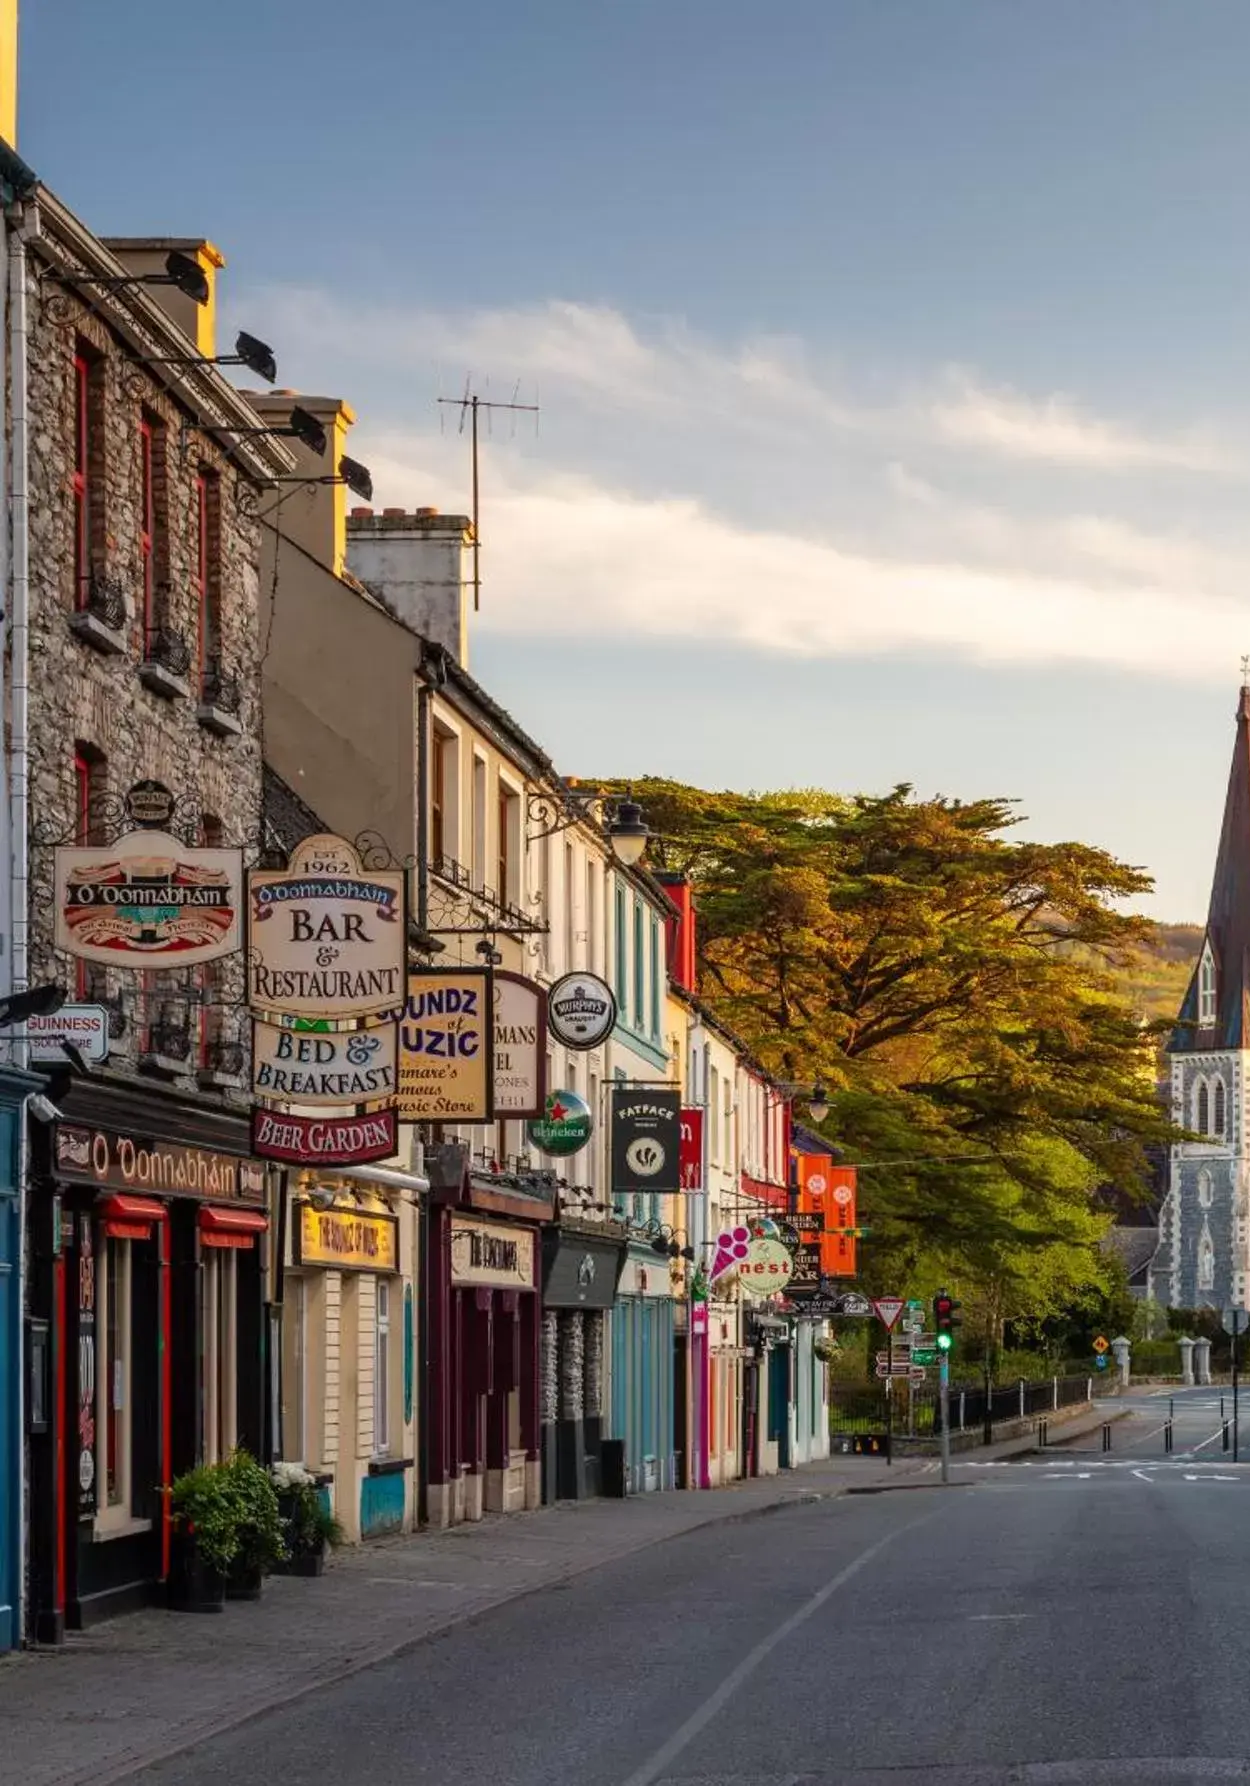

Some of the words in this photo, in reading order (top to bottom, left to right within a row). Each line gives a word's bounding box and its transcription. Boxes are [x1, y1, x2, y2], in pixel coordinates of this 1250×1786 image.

[303, 861, 351, 874] 1962
[289, 909, 374, 942] BAR
[316, 945, 340, 967] &
[254, 965, 399, 1000] RESTAURANT
[27, 1016, 101, 1032] GUINNESS
[447, 1016, 464, 1035] of
[275, 1032, 336, 1063] BED
[346, 1034, 381, 1066] &
[256, 1061, 393, 1096] BREAKFAST
[433, 1096, 475, 1112] Store
[257, 1116, 309, 1154] BEER
[308, 1119, 390, 1153] GARDEN
[739, 1261, 790, 1274] nest
